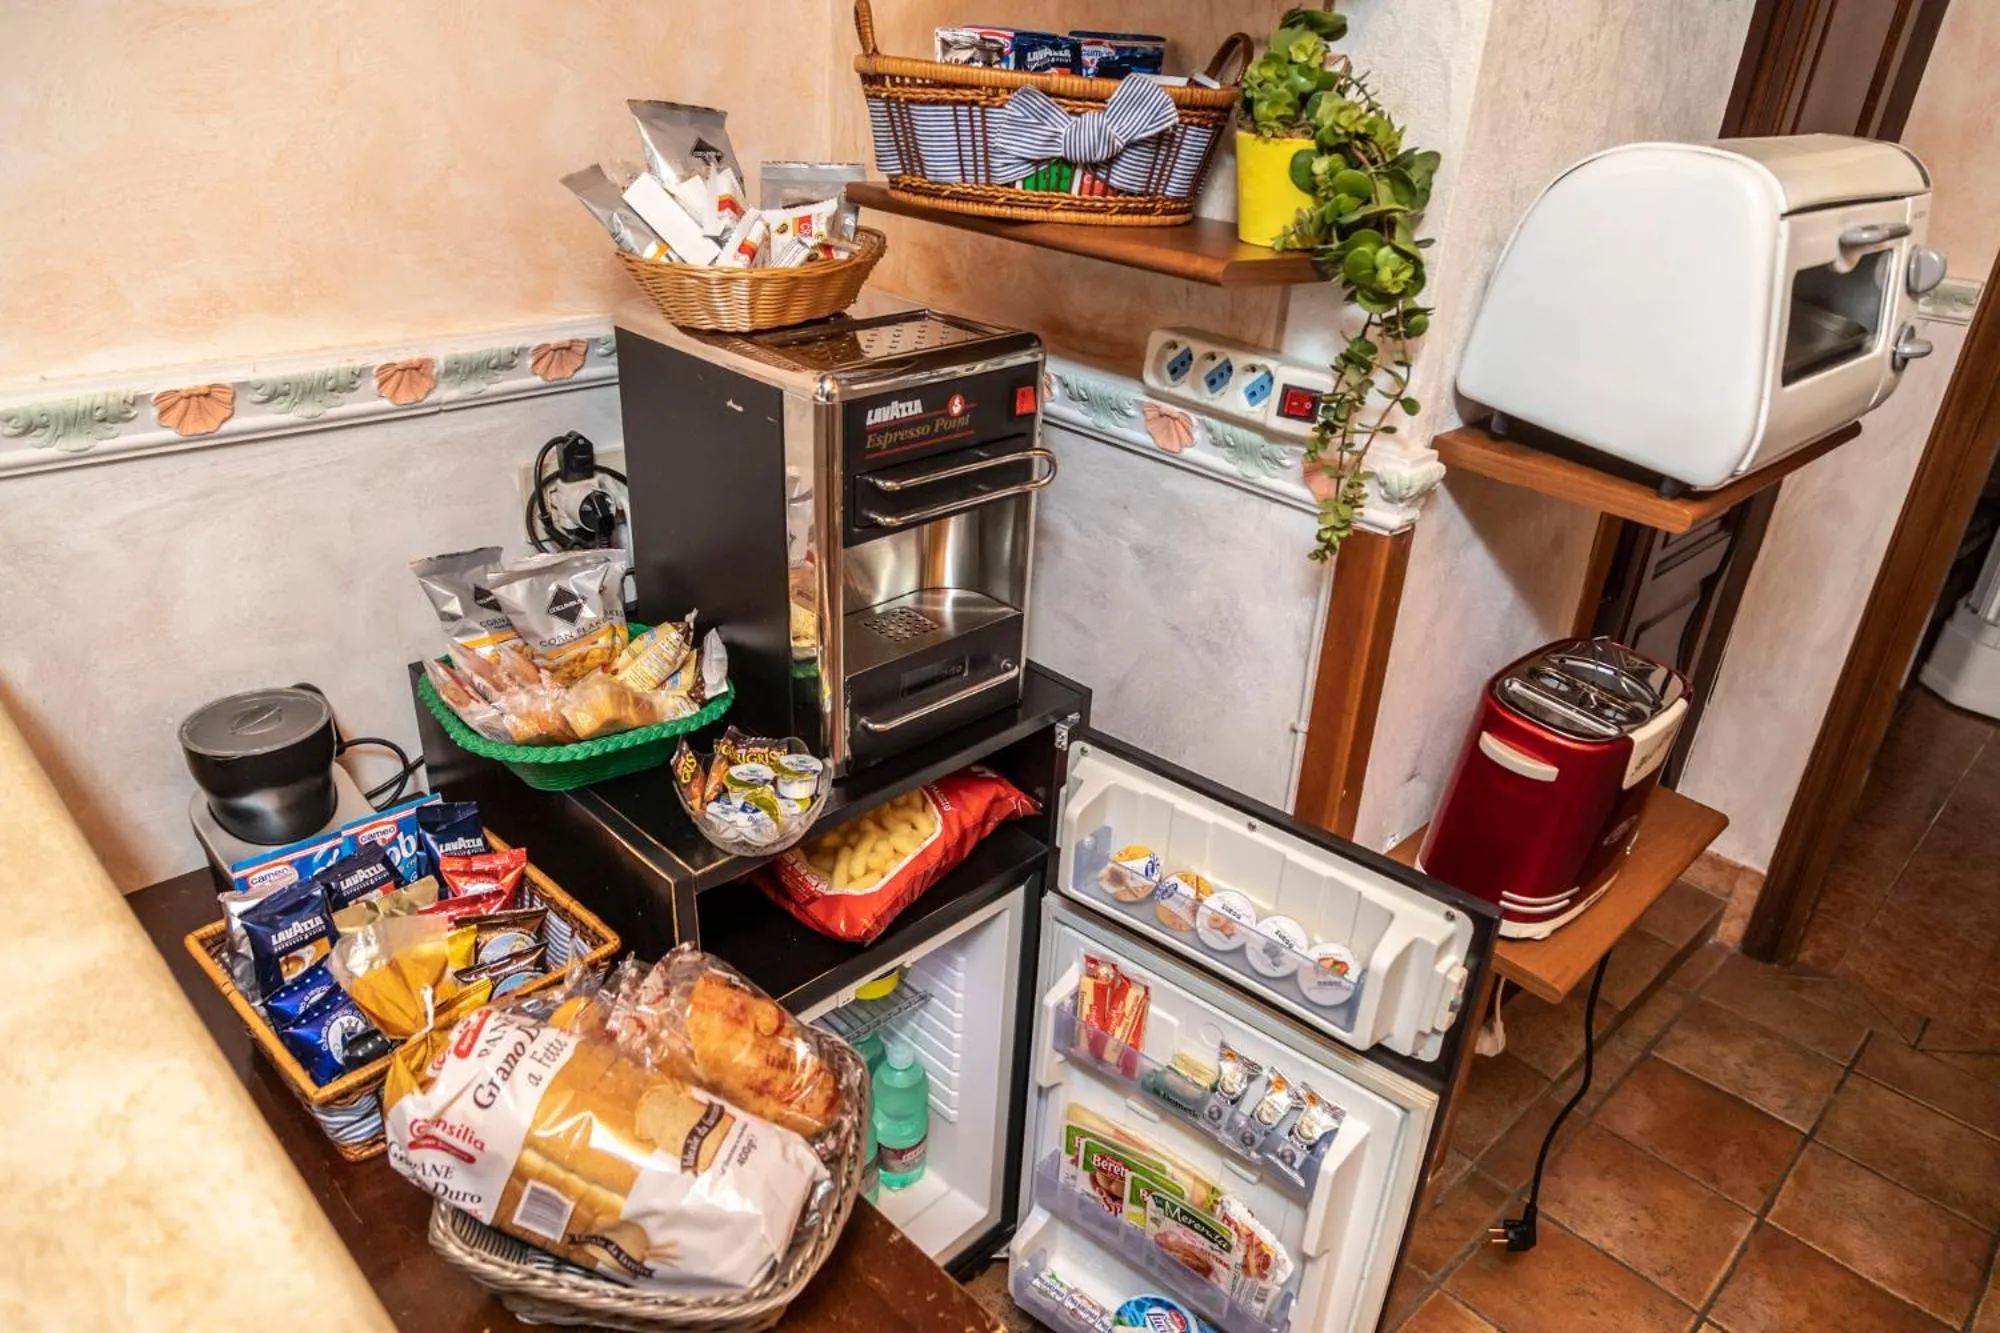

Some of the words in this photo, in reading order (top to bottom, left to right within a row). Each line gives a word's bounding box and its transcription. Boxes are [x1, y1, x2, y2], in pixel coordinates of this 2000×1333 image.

[865, 398, 924, 426] LAVAZZA
[865, 424, 931, 450] Espresso
[933, 411, 971, 434] Point
[359, 824, 396, 844] cameo
[438, 836, 484, 854] LAVAZZA
[250, 864, 291, 887] cameo
[339, 862, 387, 891] LAVAZZA
[271, 914, 325, 946] LAVAZZA
[472, 1039, 527, 1110] Grano
[527, 1071, 544, 1088] a
[419, 1160, 456, 1180] ANE
[432, 1181, 483, 1205] Duro
